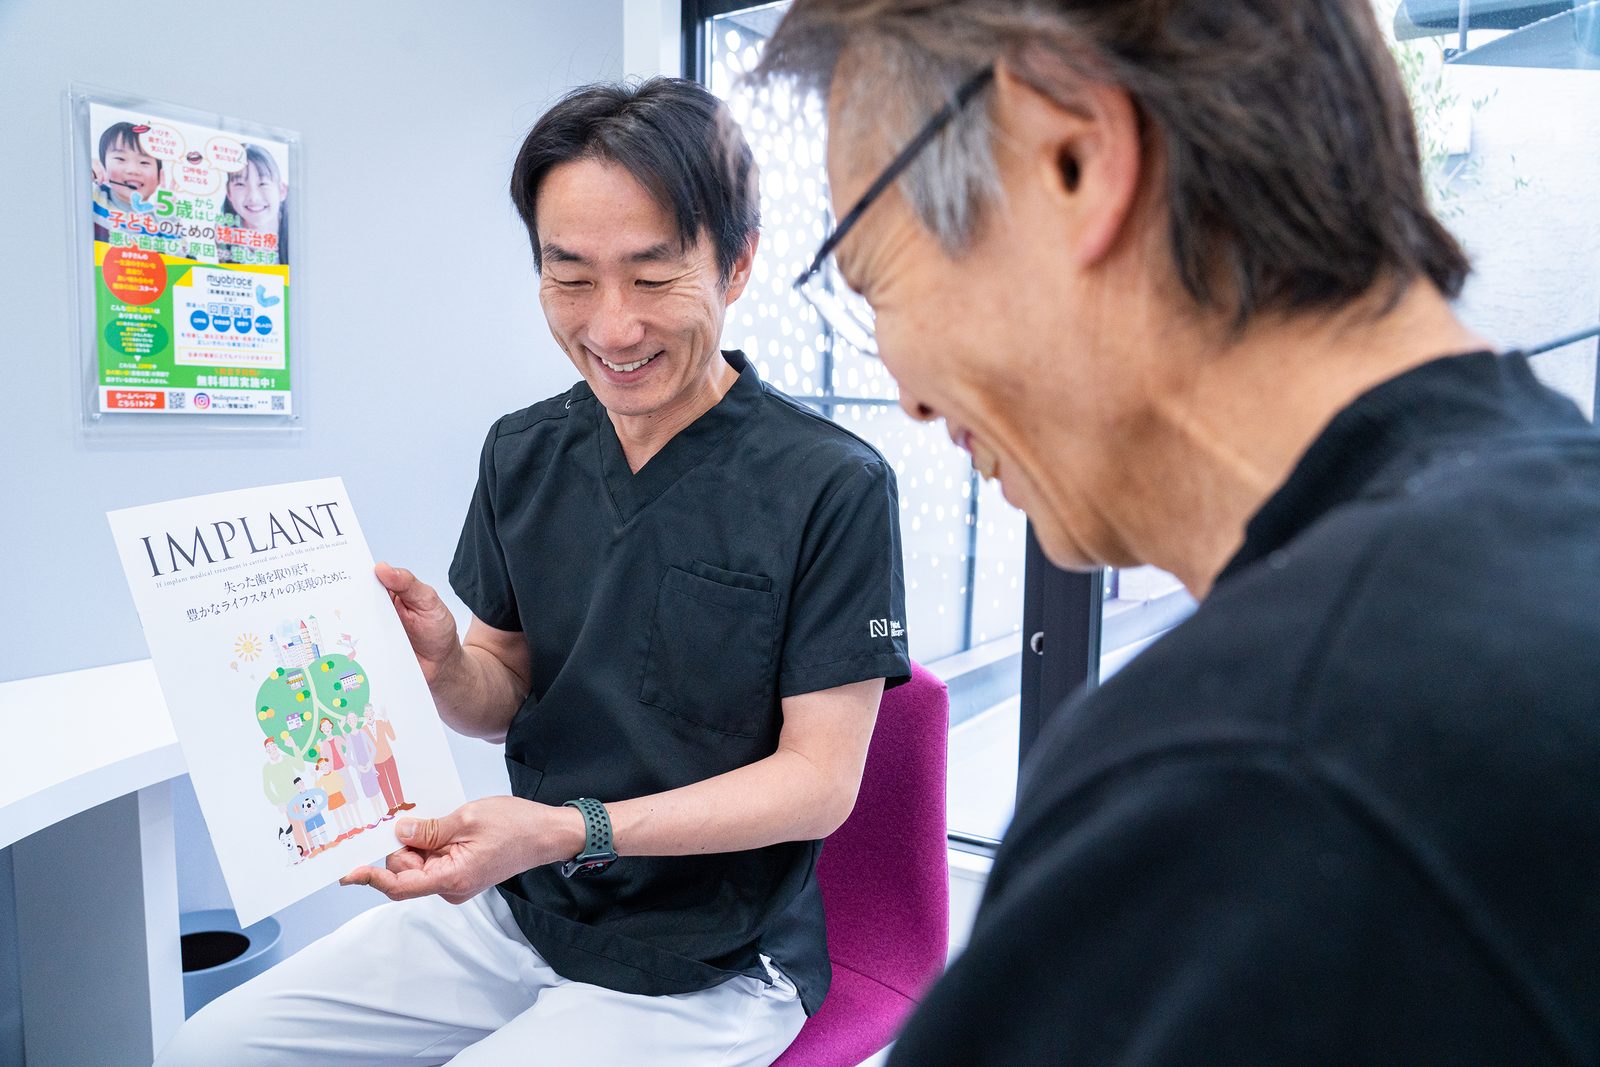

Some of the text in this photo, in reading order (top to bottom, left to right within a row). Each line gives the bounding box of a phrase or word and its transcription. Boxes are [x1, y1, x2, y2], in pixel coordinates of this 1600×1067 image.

[207, 273, 252, 287] myobrace
[139, 501, 345, 578] IMPLANT
[164, 576, 189, 587] implant
[190, 570, 213, 580] medical
[214, 564, 242, 574] treatment
[224, 562, 316, 595] 失った歯を取り戻す。
[186, 569, 353, 623] 豊かなライフスタイルの実現のために。
